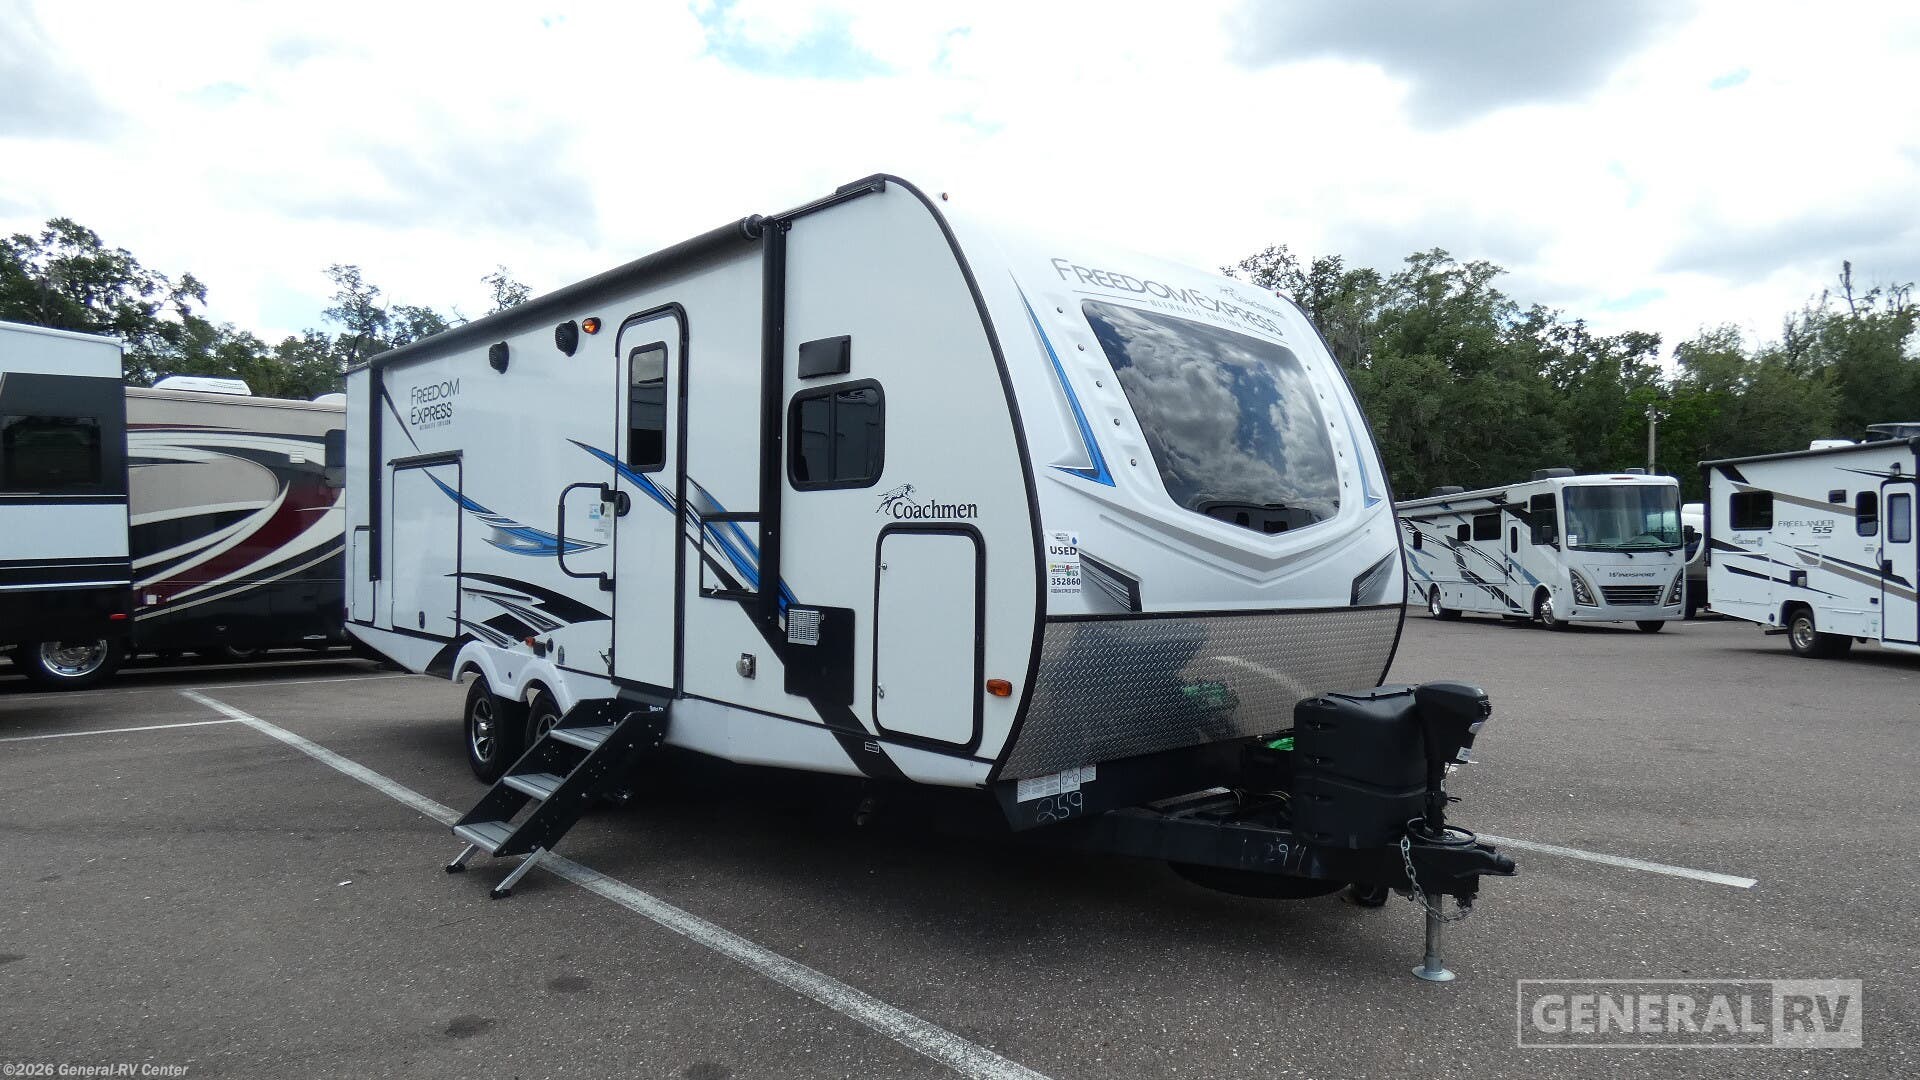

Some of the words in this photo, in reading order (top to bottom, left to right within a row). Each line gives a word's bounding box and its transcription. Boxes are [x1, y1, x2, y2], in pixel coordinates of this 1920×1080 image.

[411, 377, 460, 406] FREEDOM
[411, 401, 453, 425] EXPRESS
[892, 499, 978, 520] Coachmen
[1778, 519, 1835, 528] FREELANDER
[1049, 545, 1078, 556] USED
[1051, 577, 1081, 586] 352860
[1037, 791, 1083, 821] 259
